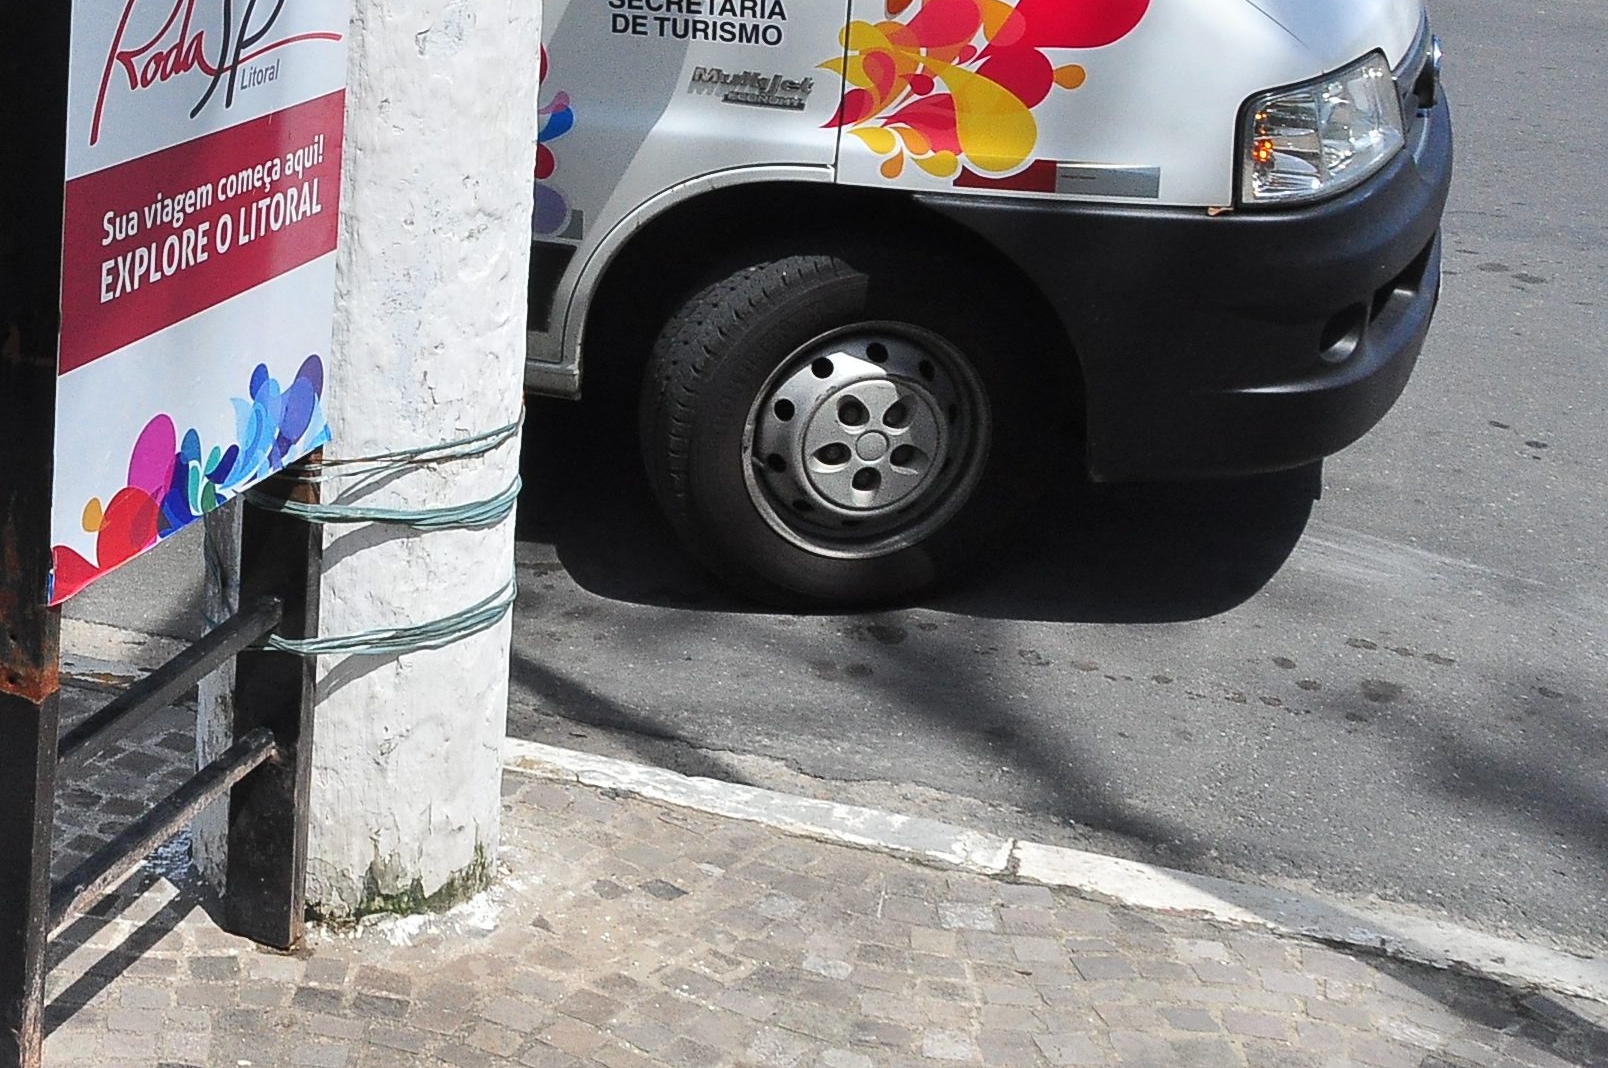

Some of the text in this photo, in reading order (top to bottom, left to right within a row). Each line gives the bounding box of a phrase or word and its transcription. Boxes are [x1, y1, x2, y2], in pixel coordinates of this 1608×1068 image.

[611, 13, 784, 46] DE TURISMO
[240, 59, 280, 91] Litoral
[726, 91, 803, 107] ECONOMY
[101, 134, 325, 247] Sua viagem começa aqui!
[100, 177, 322, 305] EXPLORE O LITORAL
